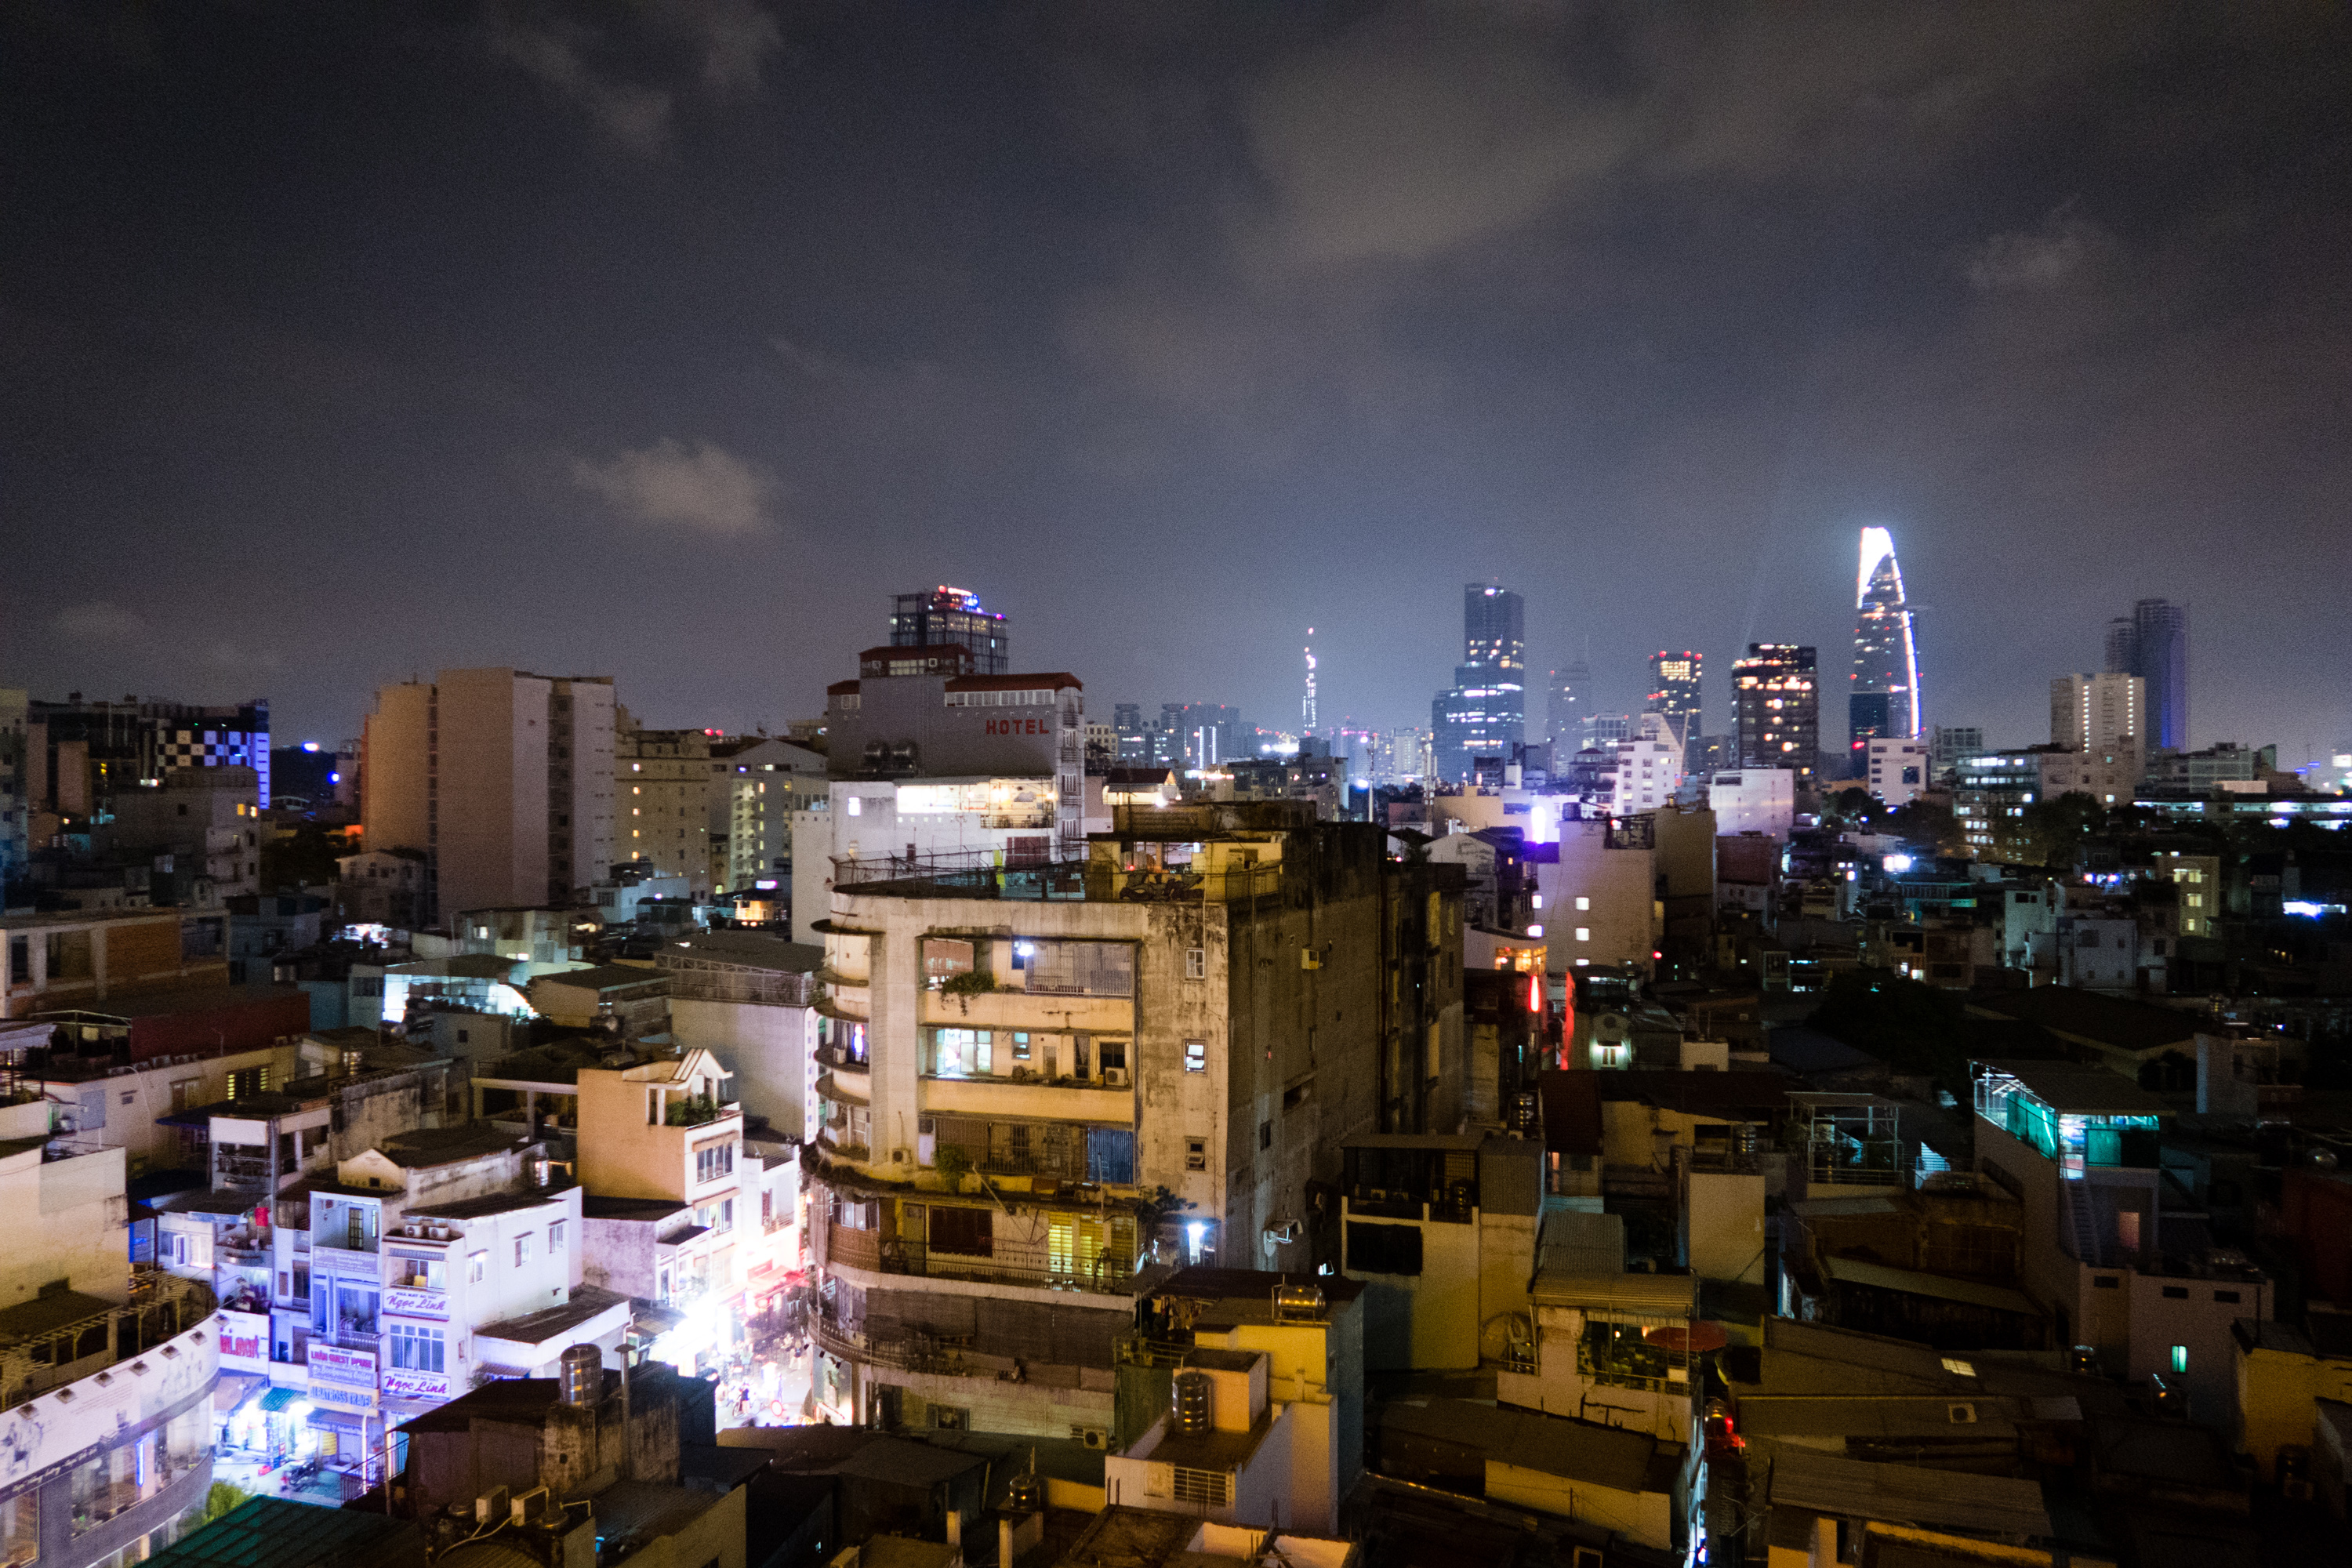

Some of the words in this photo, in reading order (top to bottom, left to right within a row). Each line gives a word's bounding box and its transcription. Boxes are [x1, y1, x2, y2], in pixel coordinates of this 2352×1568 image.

[985, 719, 1050, 735] HOTEL
[416, 1298, 446, 1311] Linh
[415, 1381, 447, 1394] Linh
